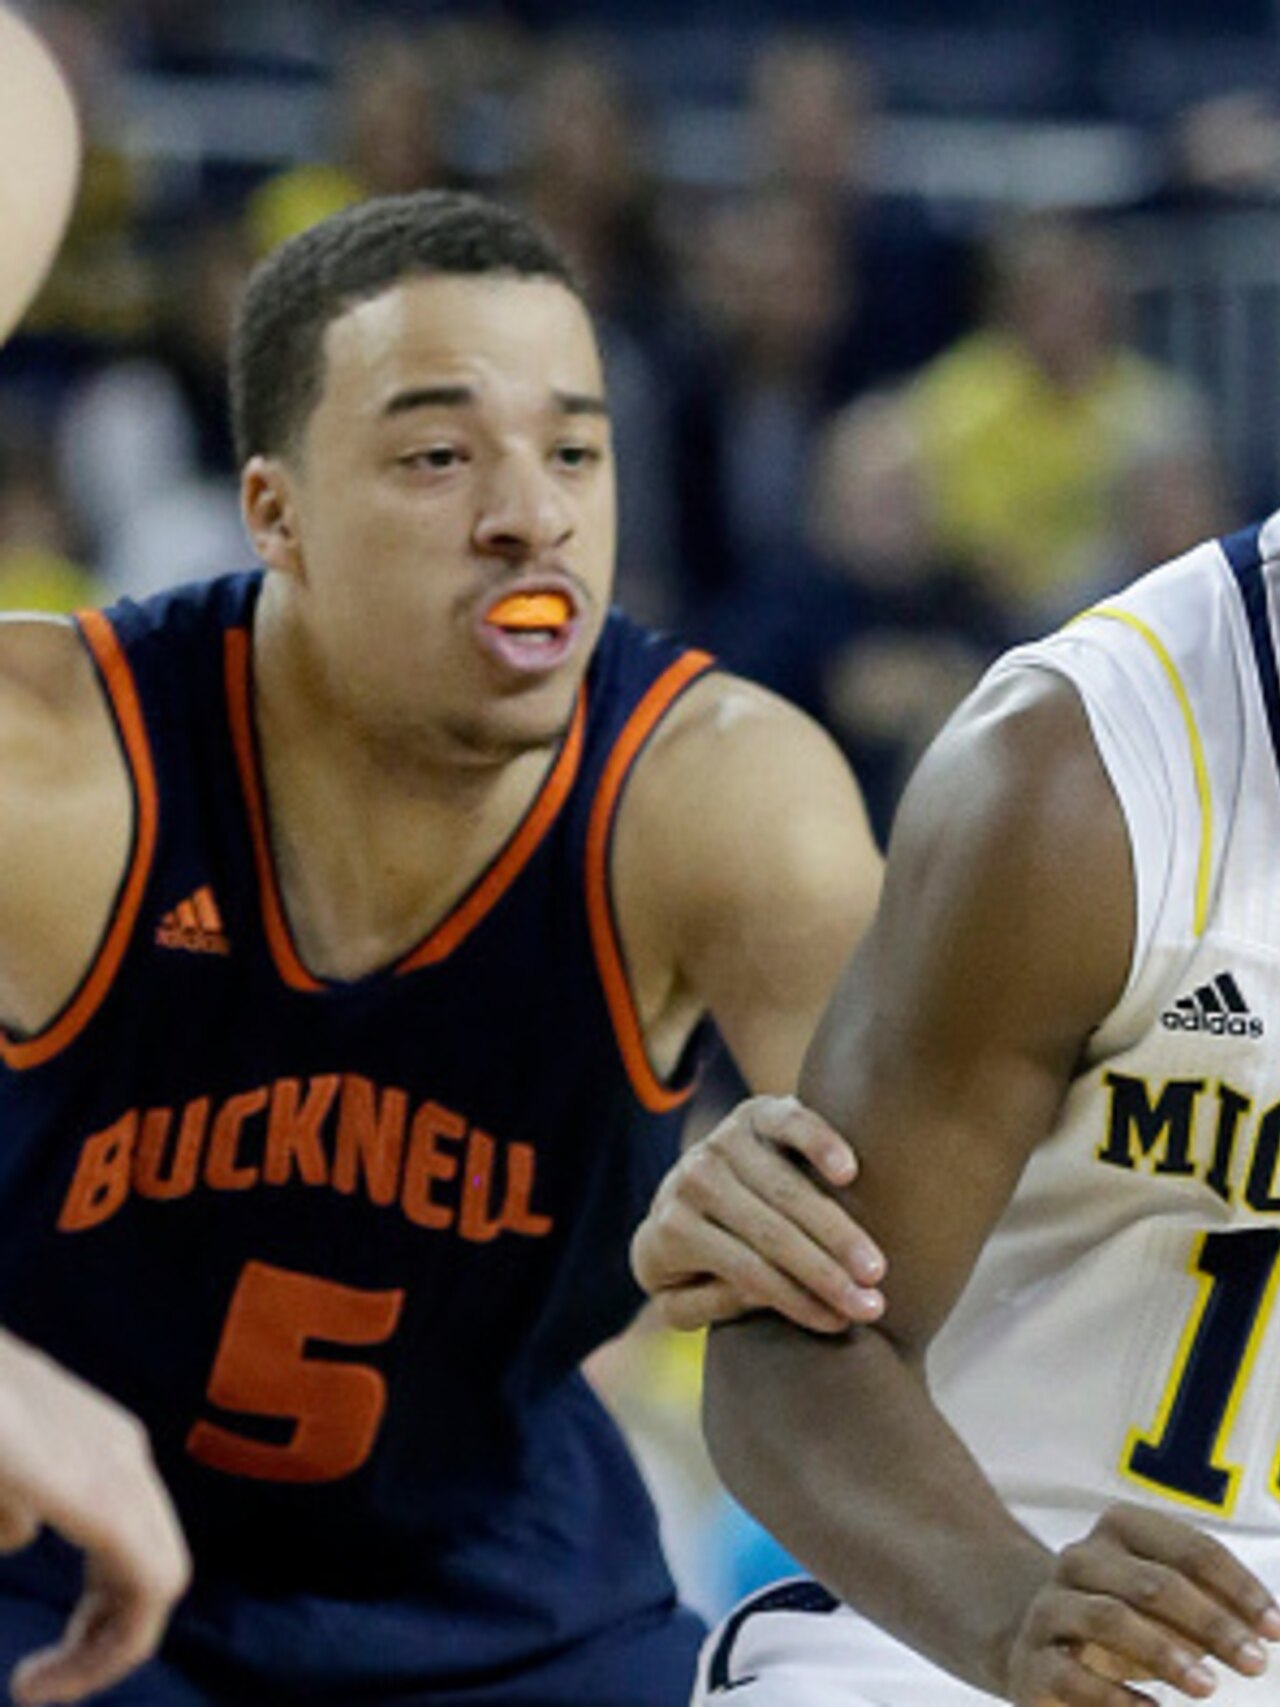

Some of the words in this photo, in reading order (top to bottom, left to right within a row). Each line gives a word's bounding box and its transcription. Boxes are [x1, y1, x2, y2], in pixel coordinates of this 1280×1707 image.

[1162, 1008, 1264, 1038] adidas
[57, 1073, 553, 1243] BUCKNELL
[186, 1259, 405, 1484] 5
